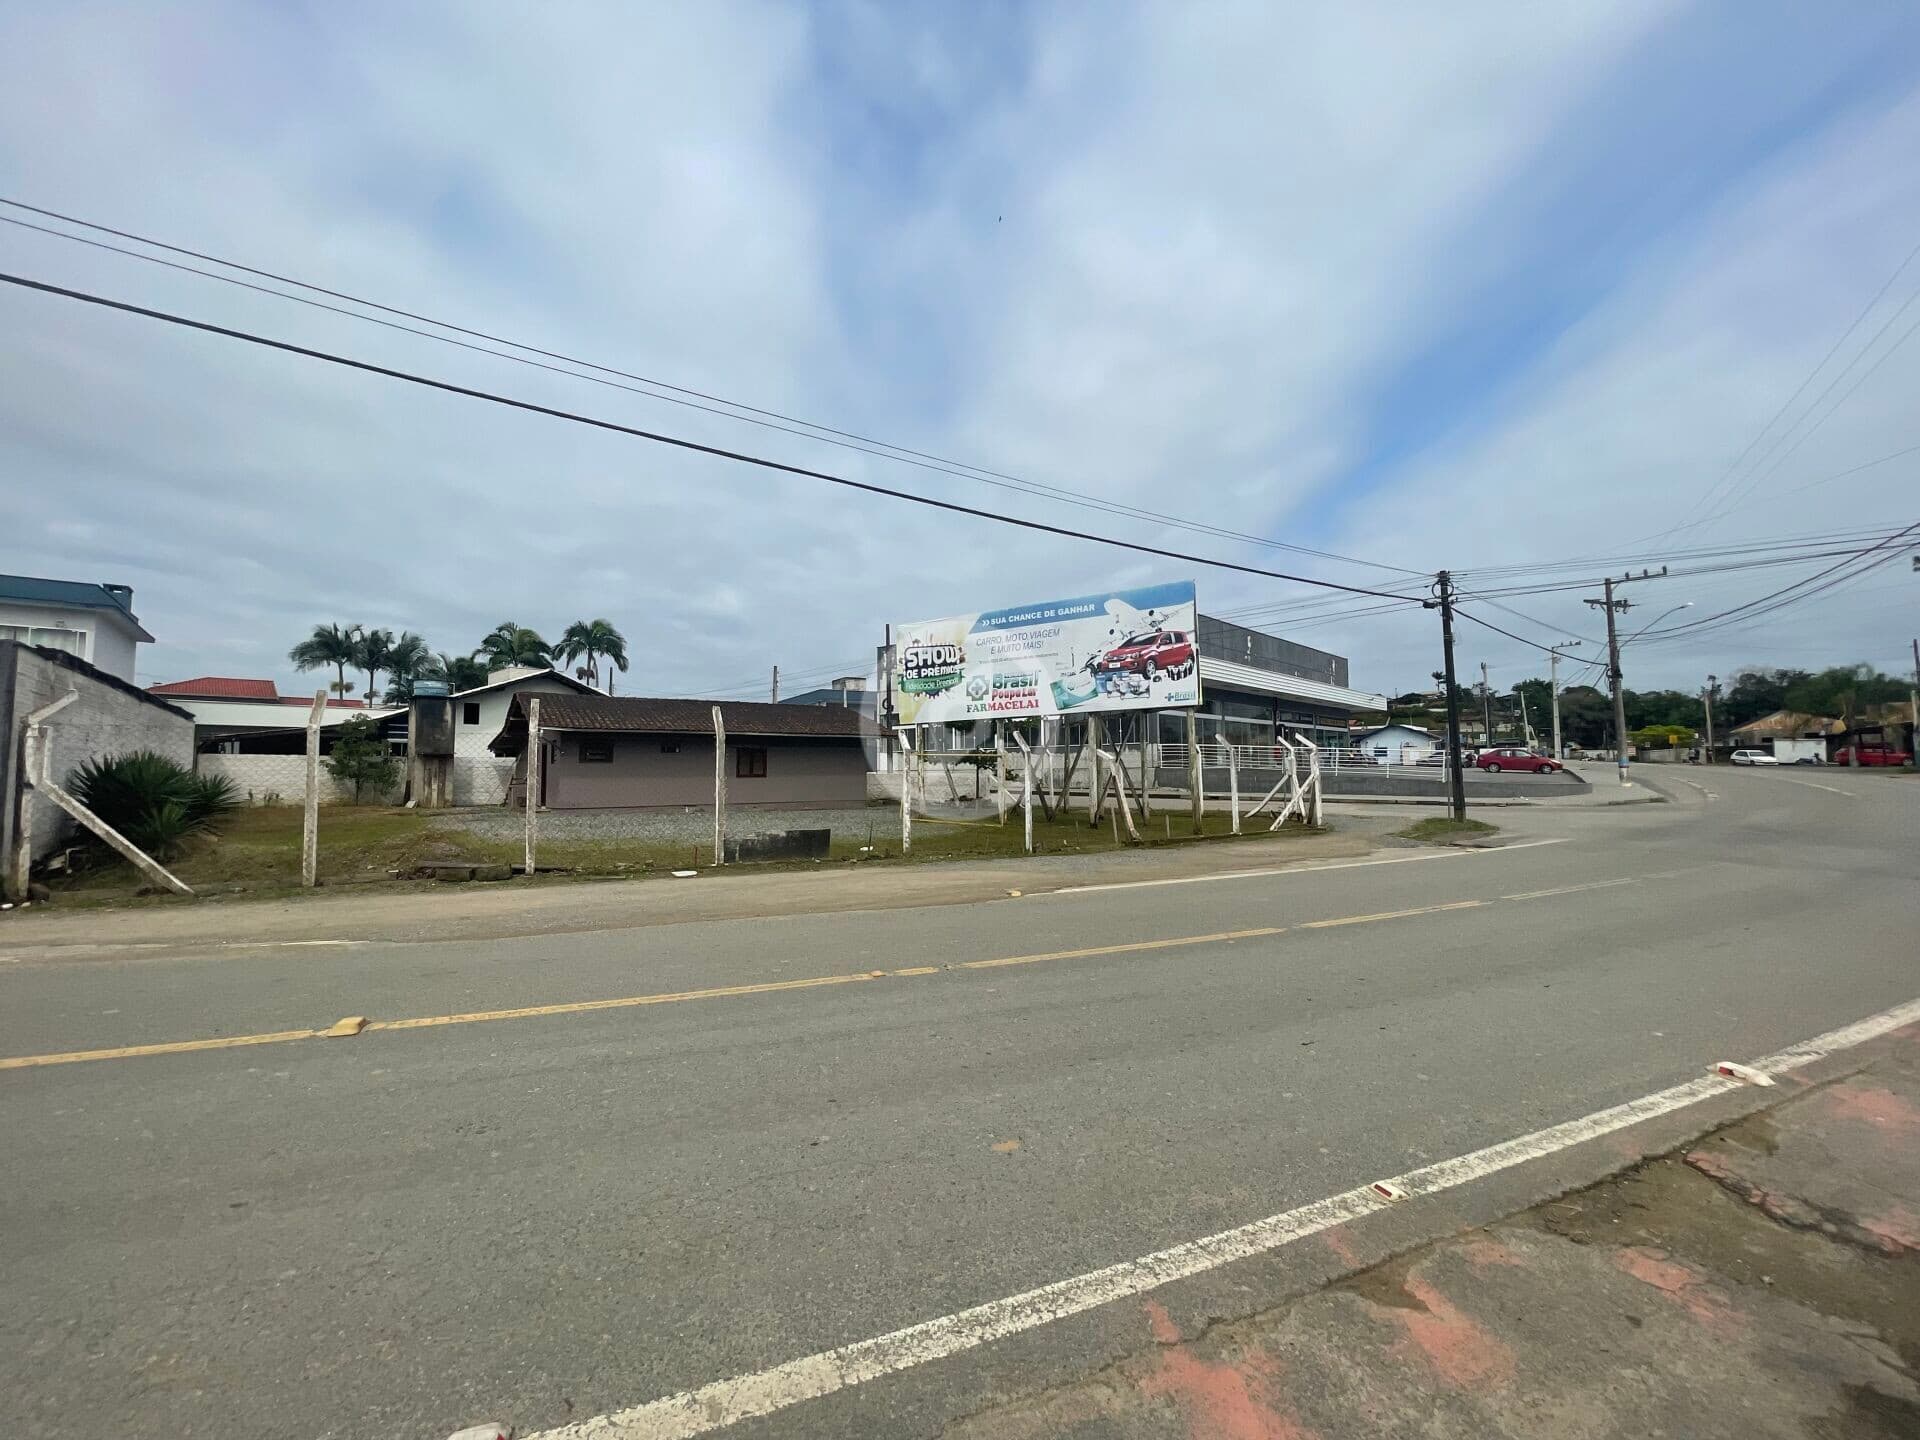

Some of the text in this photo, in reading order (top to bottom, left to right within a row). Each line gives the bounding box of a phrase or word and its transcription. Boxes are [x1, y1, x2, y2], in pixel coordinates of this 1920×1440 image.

[1008, 613, 1042, 623] CHANCE
[1058, 604, 1095, 616] GANHAR
[1030, 628, 1060, 640] VIAGEM
[997, 642, 1021, 653] MUITO
[1023, 640, 1044, 650] MAIS!
[905, 646, 958, 667] SHOW
[907, 669, 919, 679] DE
[992, 671, 1038, 689] Brasil
[966, 699, 1039, 713] FARMACELAI
